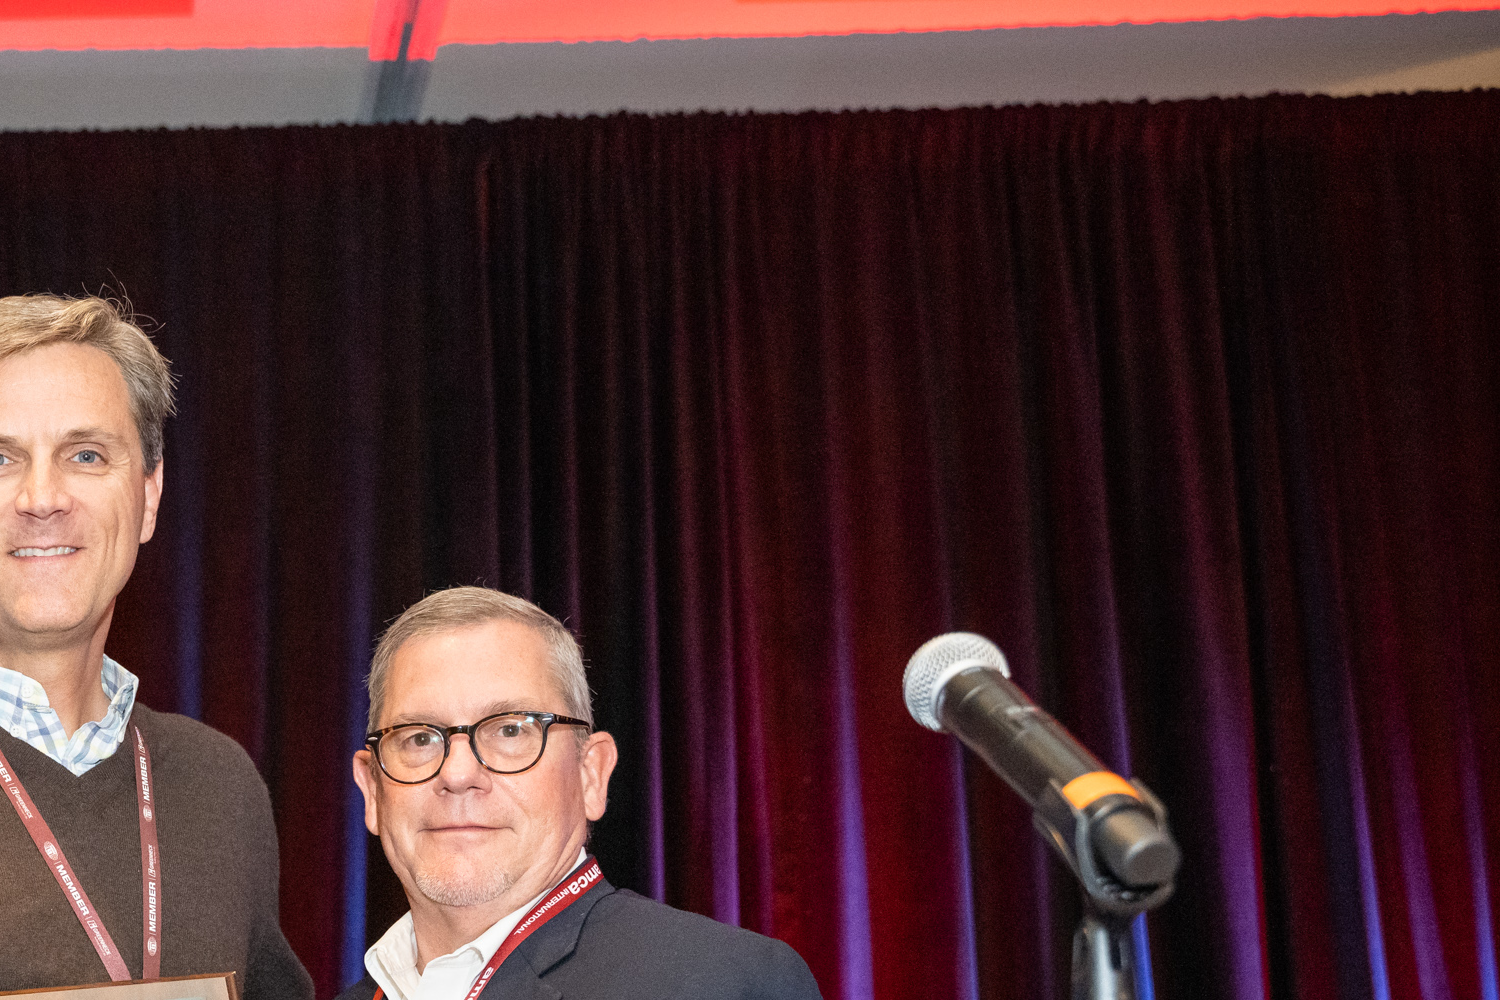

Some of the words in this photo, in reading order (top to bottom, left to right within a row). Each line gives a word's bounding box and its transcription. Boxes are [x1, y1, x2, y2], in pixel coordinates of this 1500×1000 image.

[140, 756, 150, 801] MEMBER
[56, 864, 90, 916] MEMBER
[568, 864, 602, 894] amca
[148, 882, 156, 932] MEMBER
[514, 888, 570, 936] INTERNATIONAL
